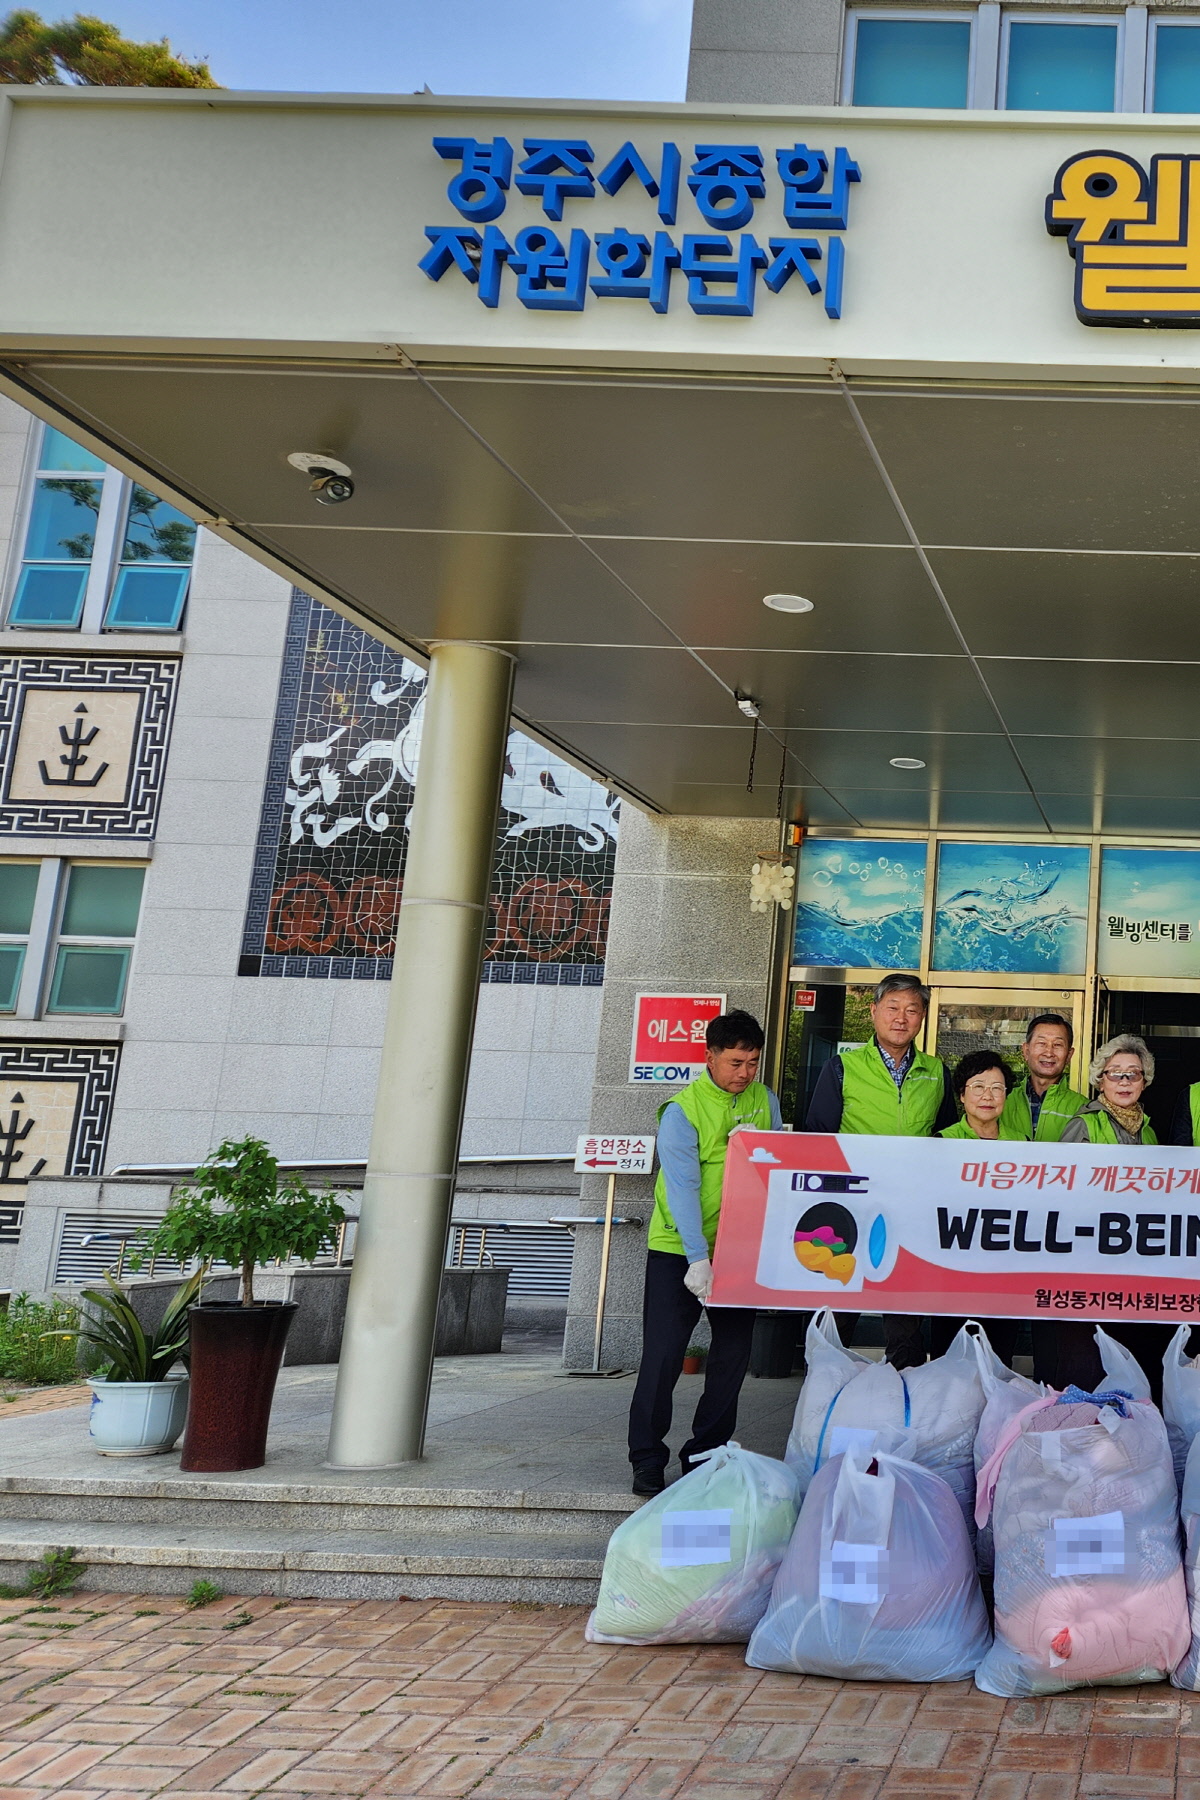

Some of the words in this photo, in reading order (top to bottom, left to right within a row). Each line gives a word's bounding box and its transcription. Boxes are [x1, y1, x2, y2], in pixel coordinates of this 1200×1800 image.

[432, 136, 862, 230] 경주시종합
[417, 225, 845, 319] 자원화단지
[1107, 915, 1191, 942] 웰빙센터를
[647, 1019, 709, 1043] 에스원
[633, 1066, 691, 1081] SECOM
[584, 1139, 646, 1155] 흡연장소
[620, 1158, 645, 1169] 정자
[960, 1161, 1077, 1190] 마음까지
